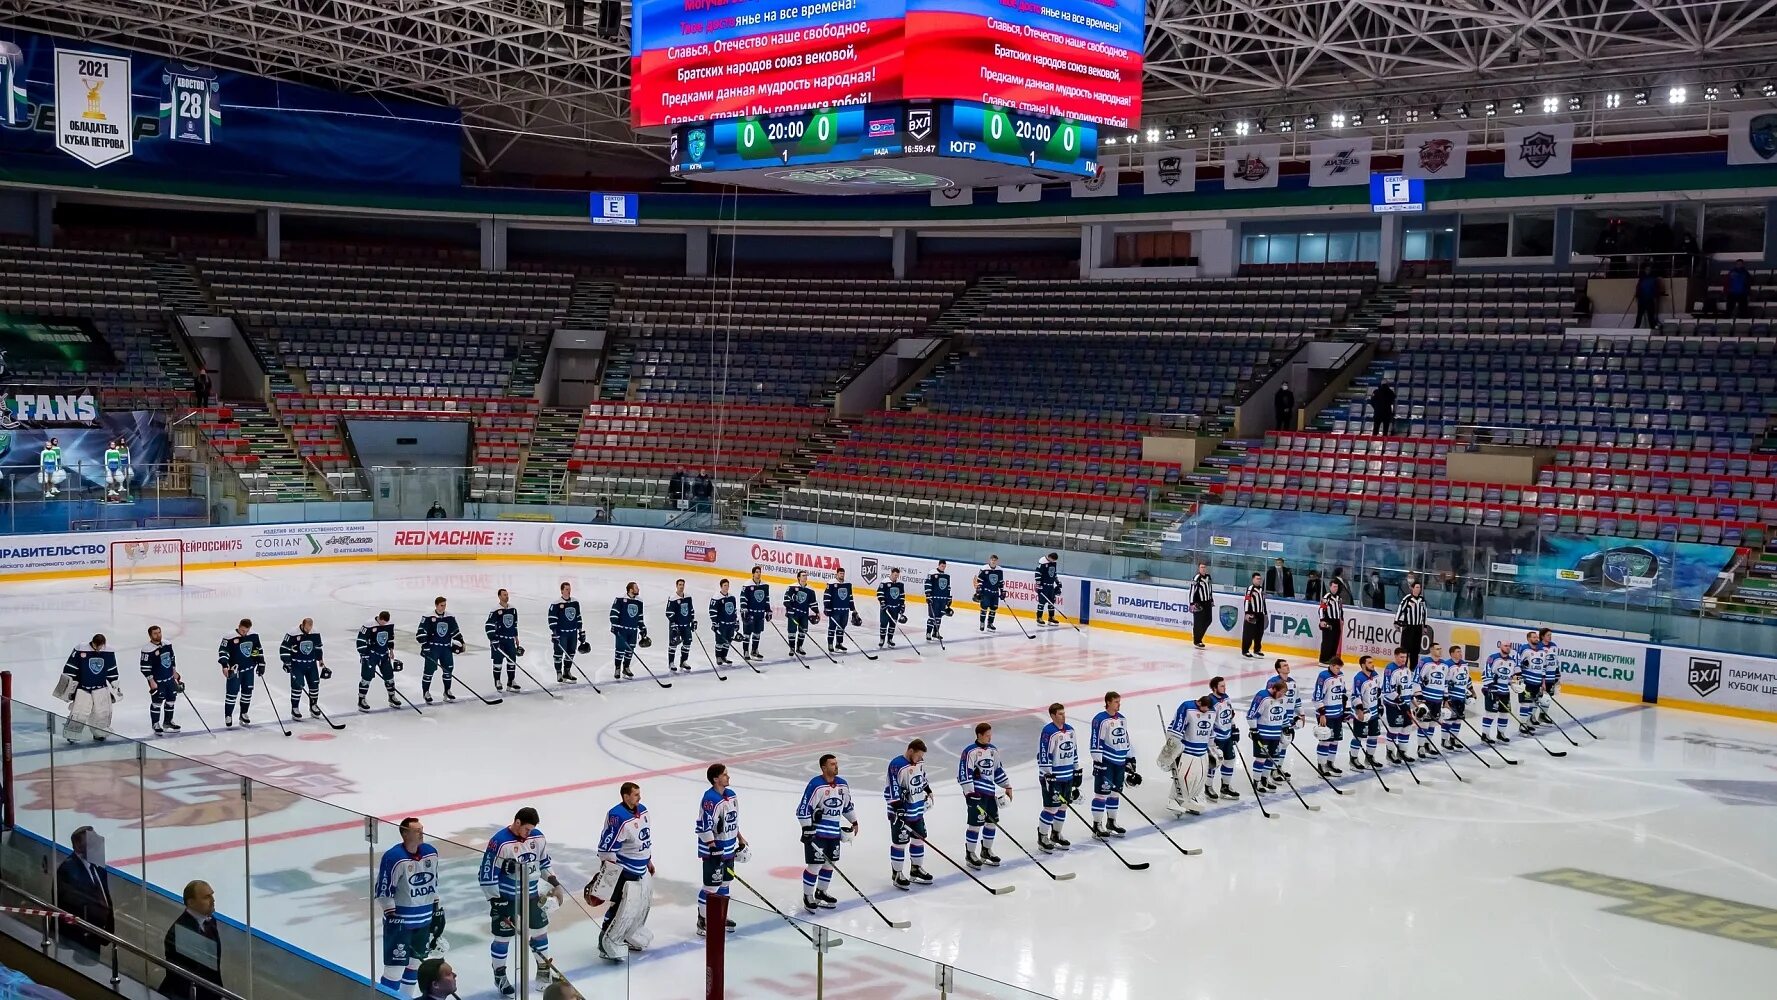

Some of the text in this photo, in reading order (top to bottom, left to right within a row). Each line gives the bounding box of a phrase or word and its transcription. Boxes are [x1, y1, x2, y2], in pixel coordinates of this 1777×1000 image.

[763, 10, 777, 22] на
[780, 7, 798, 20] все
[801, 0, 857, 18] времена!
[1061, 11, 1071, 20] на
[1072, 14, 1085, 24] все
[1085, 17, 1122, 33] времена!
[667, 22, 871, 60] Славься, Отечество наше свободное,
[987, 17, 1129, 60] Славься, Отечество наше свободное,
[78, 59, 109, 78] 2021
[677, 44, 858, 83] Братских народов союз вековой,
[994, 43, 1122, 82] Братских народов союз вековой,
[177, 77, 206, 91] ХВОСТОВ
[662, 66, 876, 107] Предками данная мудрость народная!
[980, 66, 1132, 107] Предками данная мудрость народная!
[180, 91, 201, 119] 28
[1049, 104, 1066, 117] Мы
[69, 120, 120, 135] ОБЛАДАТЕЛЬ
[743, 116, 830, 148] 0 20:00 0
[908, 116, 931, 132] ВХЛ
[990, 113, 1074, 151] 0 20:00 0
[64, 134, 125, 150] КУБКА ПЕТРОВА
[903, 145, 936, 154] 16:59:47
[950, 141, 977, 154] ЮГР
[782, 149, 788, 162] 1
[1029, 150, 1035, 164] 1
[1392, 183, 1401, 197] F
[610, 201, 619, 213] E
[16, 395, 95, 421] FANS
[394, 531, 495, 546] RED MACHINE
[584, 541, 609, 550] югра
[751, 543, 841, 570] Оазис ПЛАЗА
[862, 565, 877, 576] ВХЛ
[1117, 596, 1189, 613] ПРАВИТЕЛЬСТВ
[1346, 617, 1400, 645] Яндекс
[1588, 651, 1635, 665] АТРИБУТИКИ
[1690, 665, 1720, 683] ВХЛ
[1728, 681, 1759, 693] КУБОК
[484, 853, 492, 880] LADA
[410, 886, 436, 897] LADA
